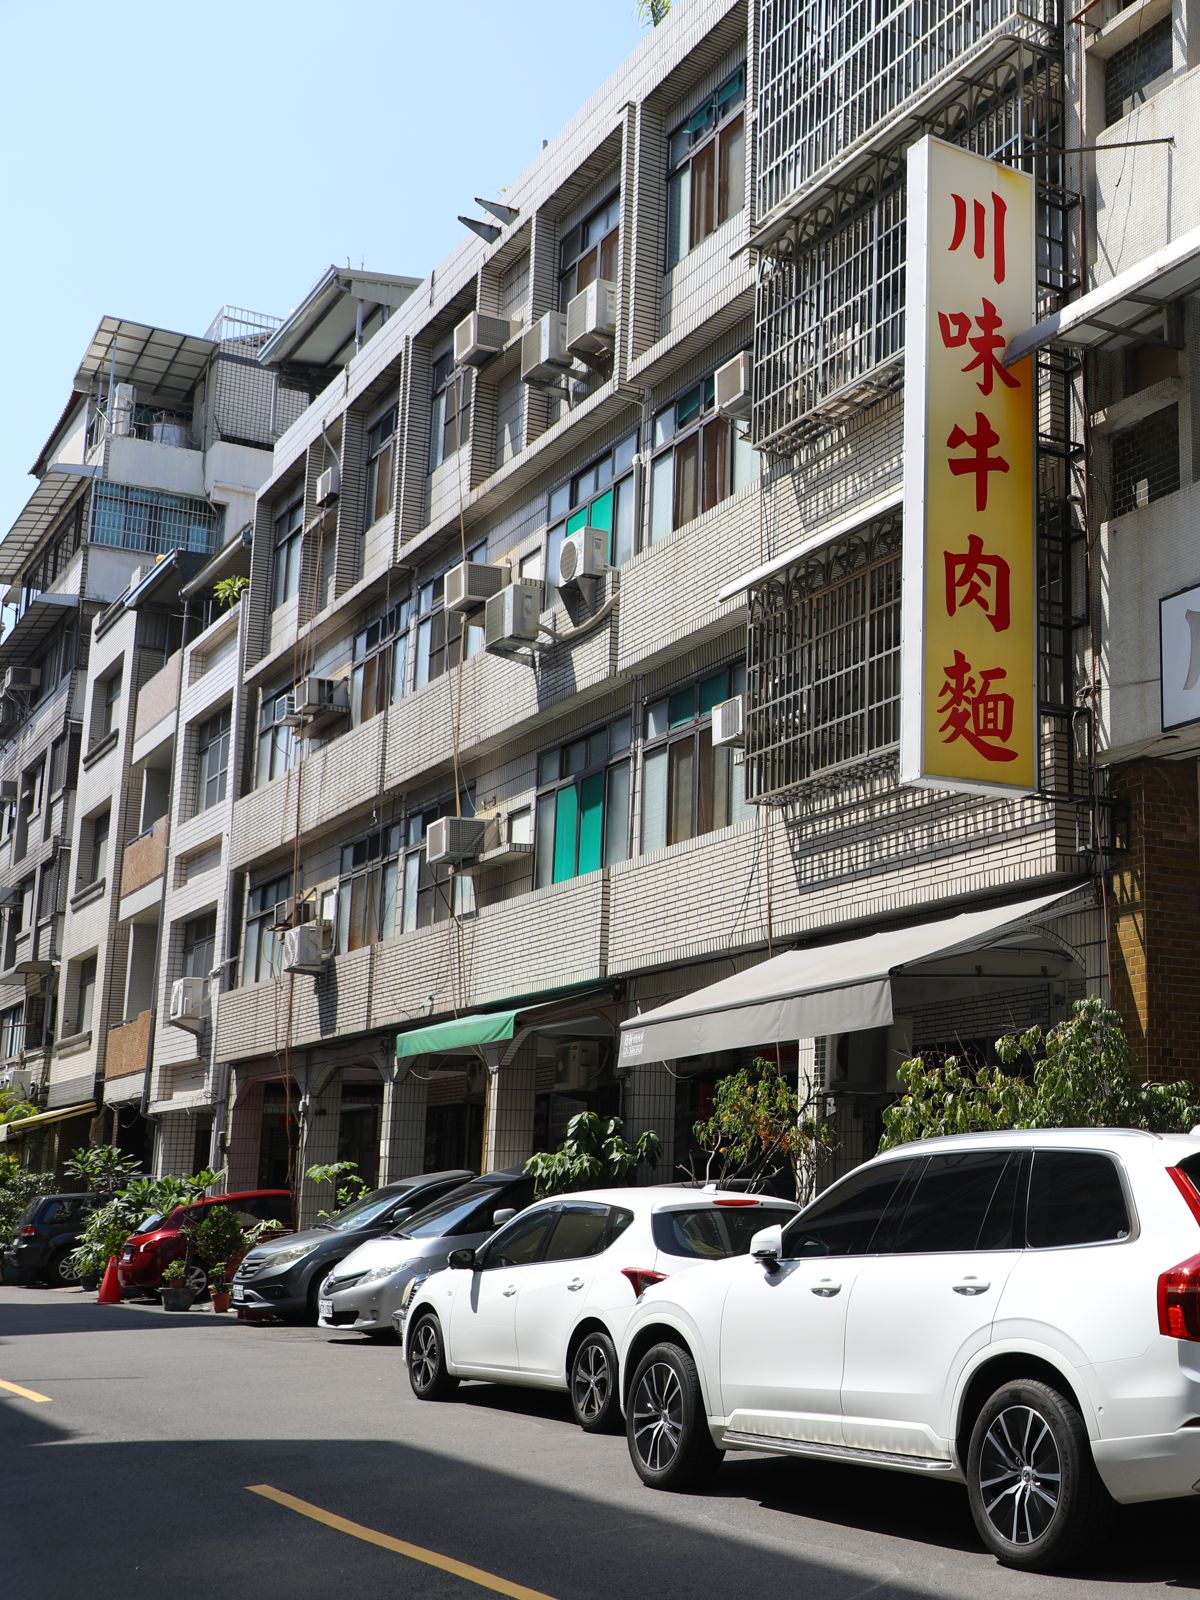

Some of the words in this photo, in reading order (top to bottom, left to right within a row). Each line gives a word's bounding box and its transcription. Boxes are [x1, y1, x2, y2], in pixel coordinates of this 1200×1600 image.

[937, 190, 1021, 763] 川味牛肉麵
